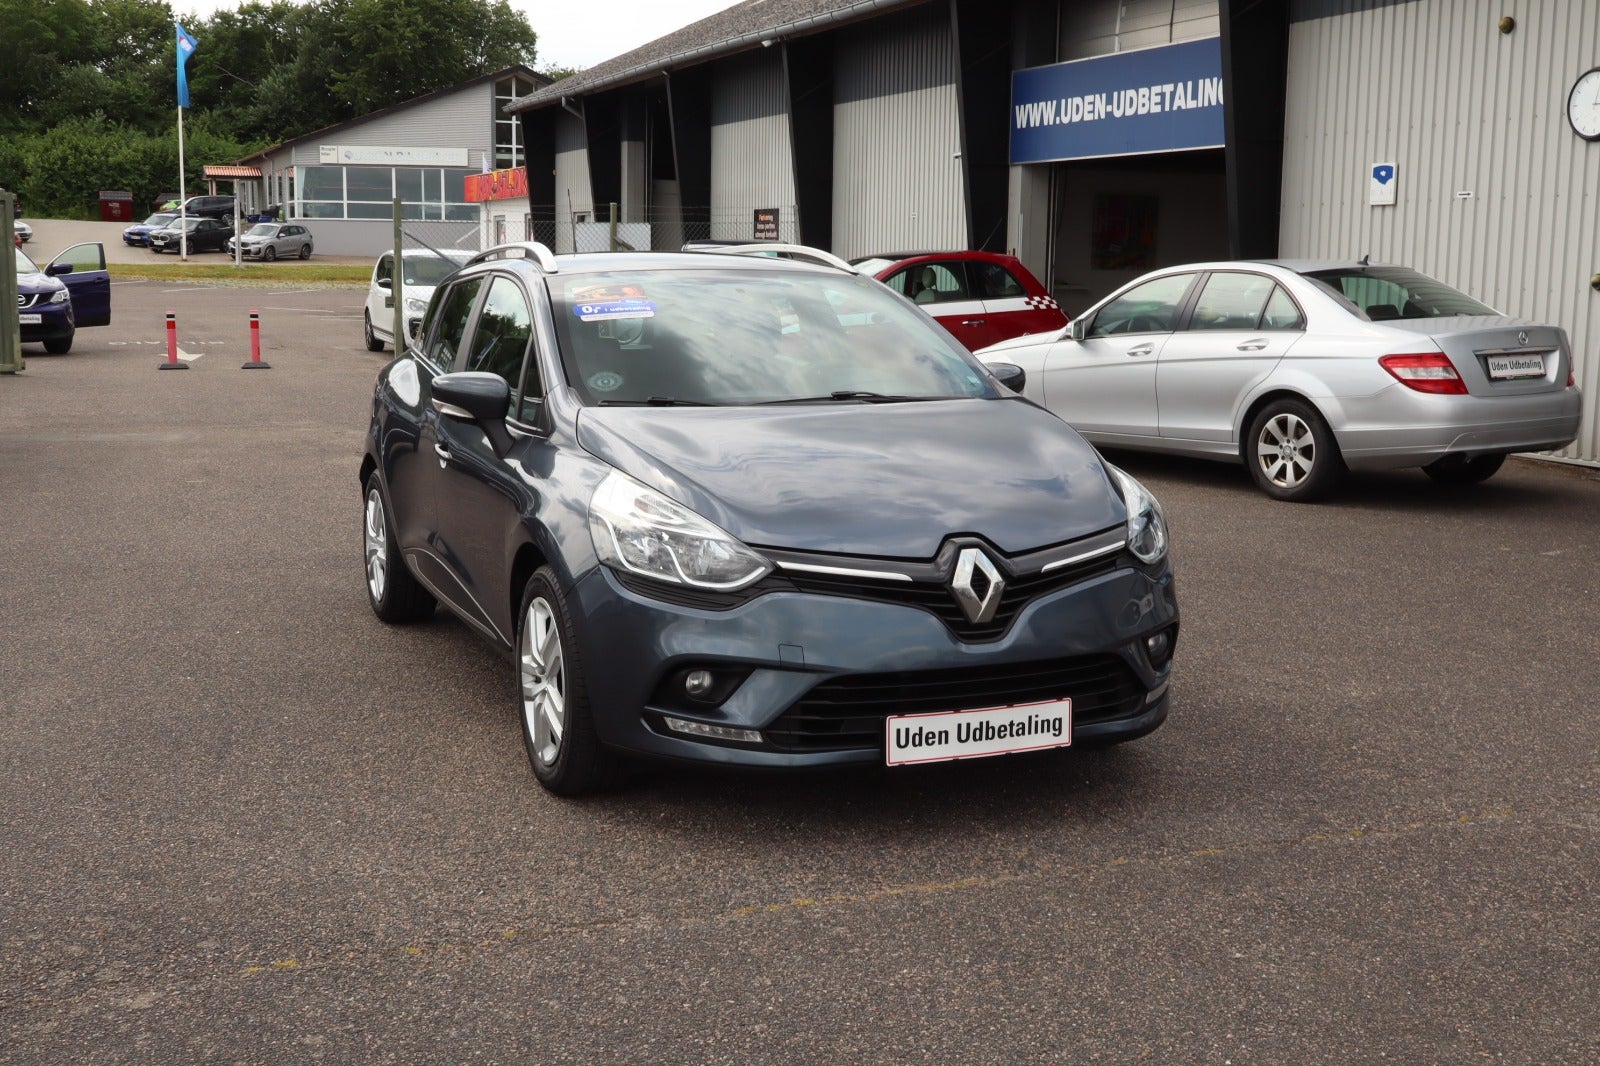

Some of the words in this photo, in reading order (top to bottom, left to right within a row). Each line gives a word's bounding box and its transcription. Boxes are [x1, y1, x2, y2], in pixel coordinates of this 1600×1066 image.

[1491, 361, 1508, 371] Uden
[1508, 359, 1542, 370] Udbetaling
[895, 726, 949, 749] Uden
[956, 714, 1063, 744] Udbetaling
